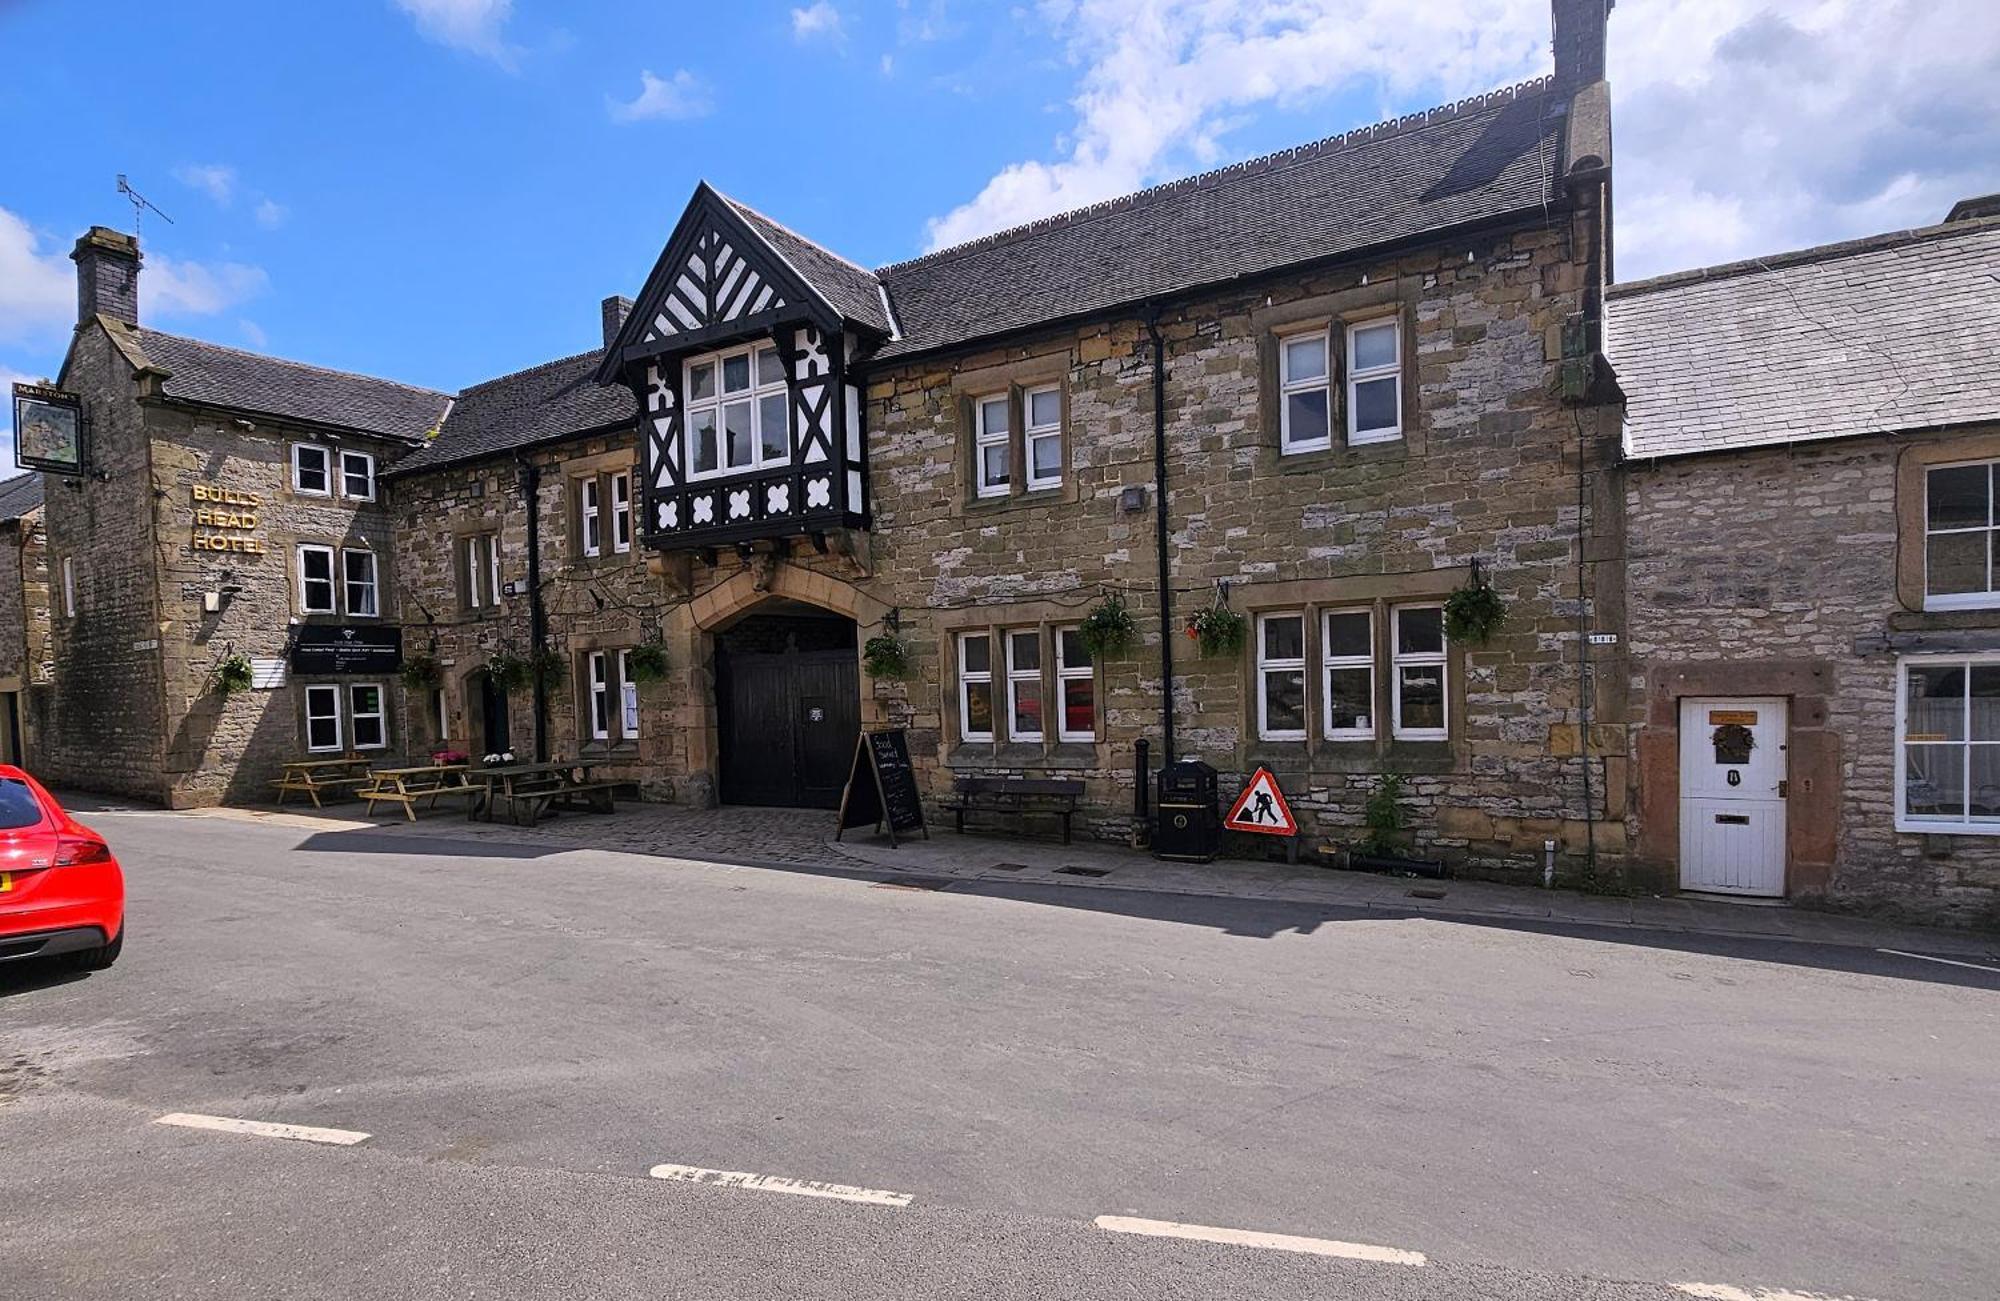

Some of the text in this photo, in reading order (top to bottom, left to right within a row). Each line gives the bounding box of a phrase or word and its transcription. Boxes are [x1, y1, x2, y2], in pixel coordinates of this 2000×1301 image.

[193, 484, 265, 506] BULLS
[197, 508, 257, 529] HEAD
[194, 533, 267, 554] HOTEL
